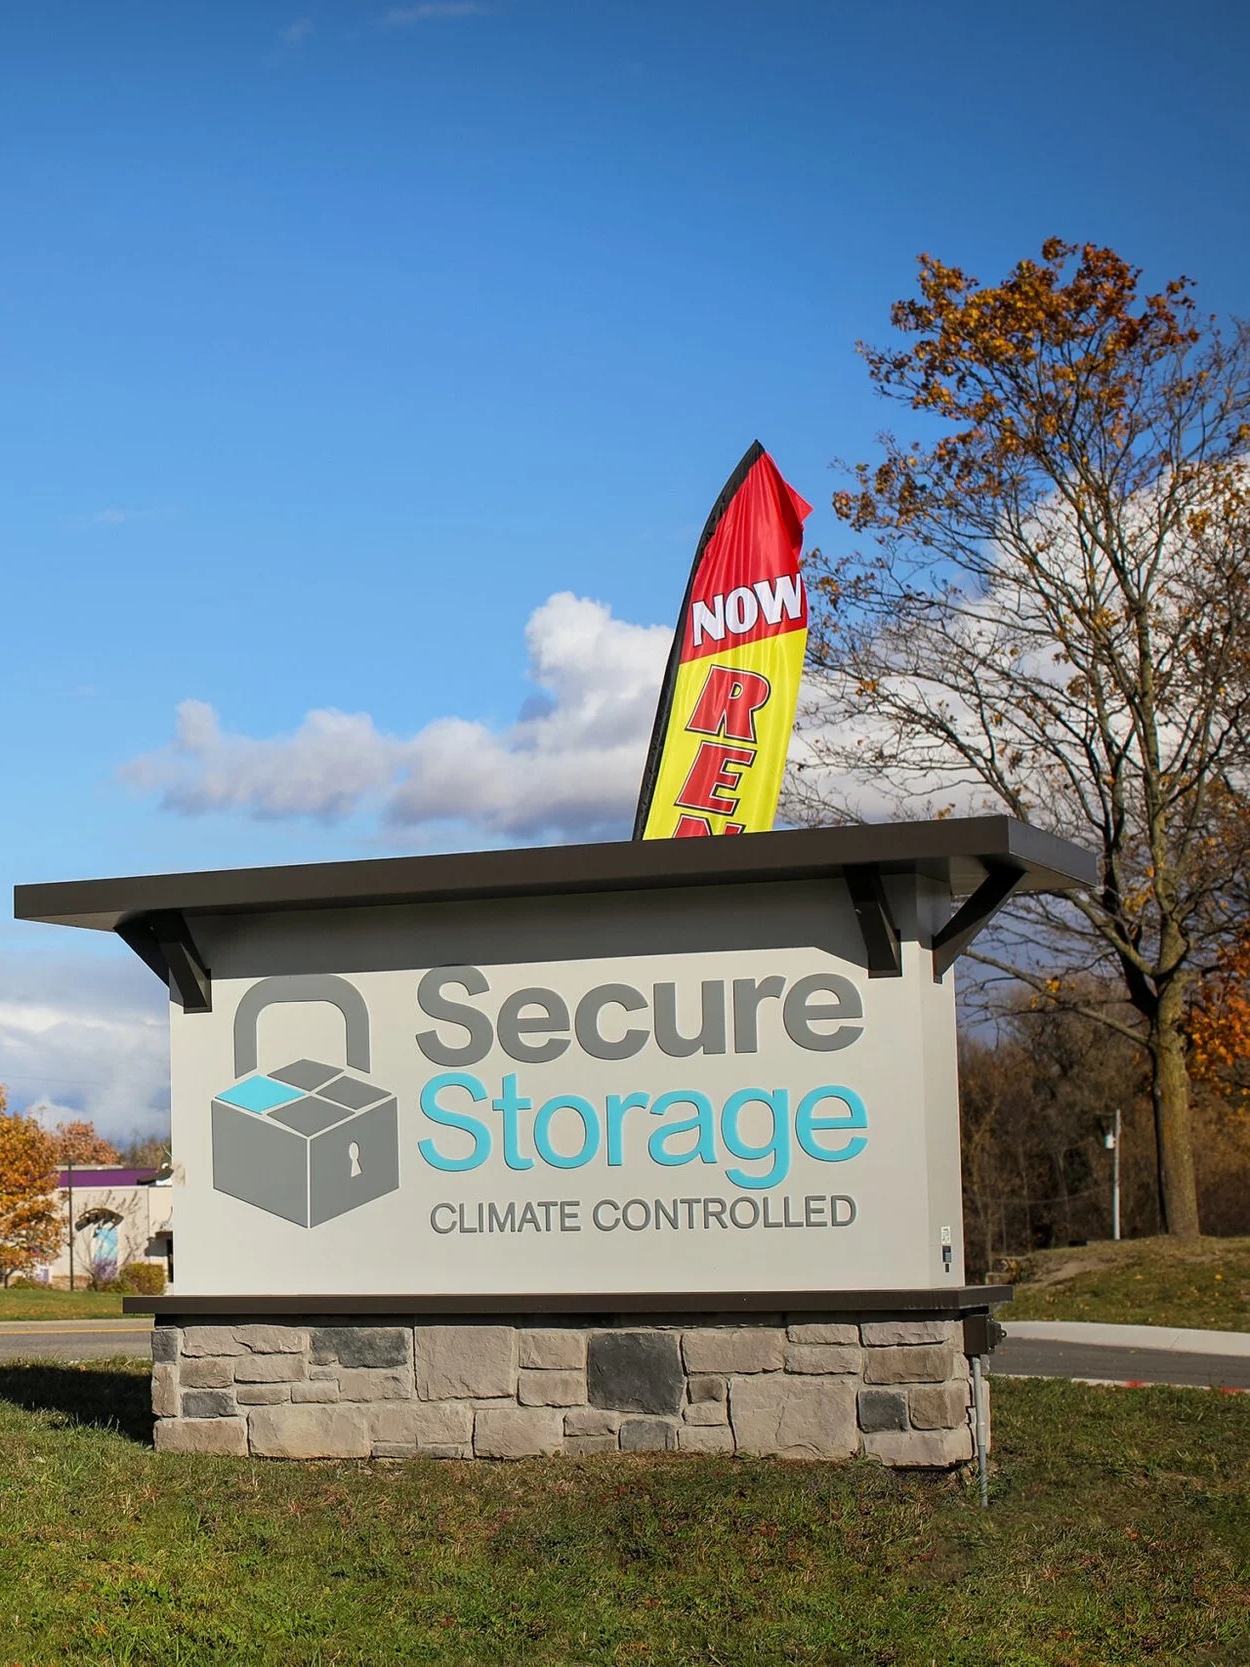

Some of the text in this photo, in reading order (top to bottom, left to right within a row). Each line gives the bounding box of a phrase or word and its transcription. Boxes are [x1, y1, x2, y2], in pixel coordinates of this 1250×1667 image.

[691, 573, 802, 647] NOW
[415, 964, 865, 1067] Secure
[417, 1072, 869, 1190] Storage
[430, 1195, 857, 1234] CLIMATE CONTROLLED
